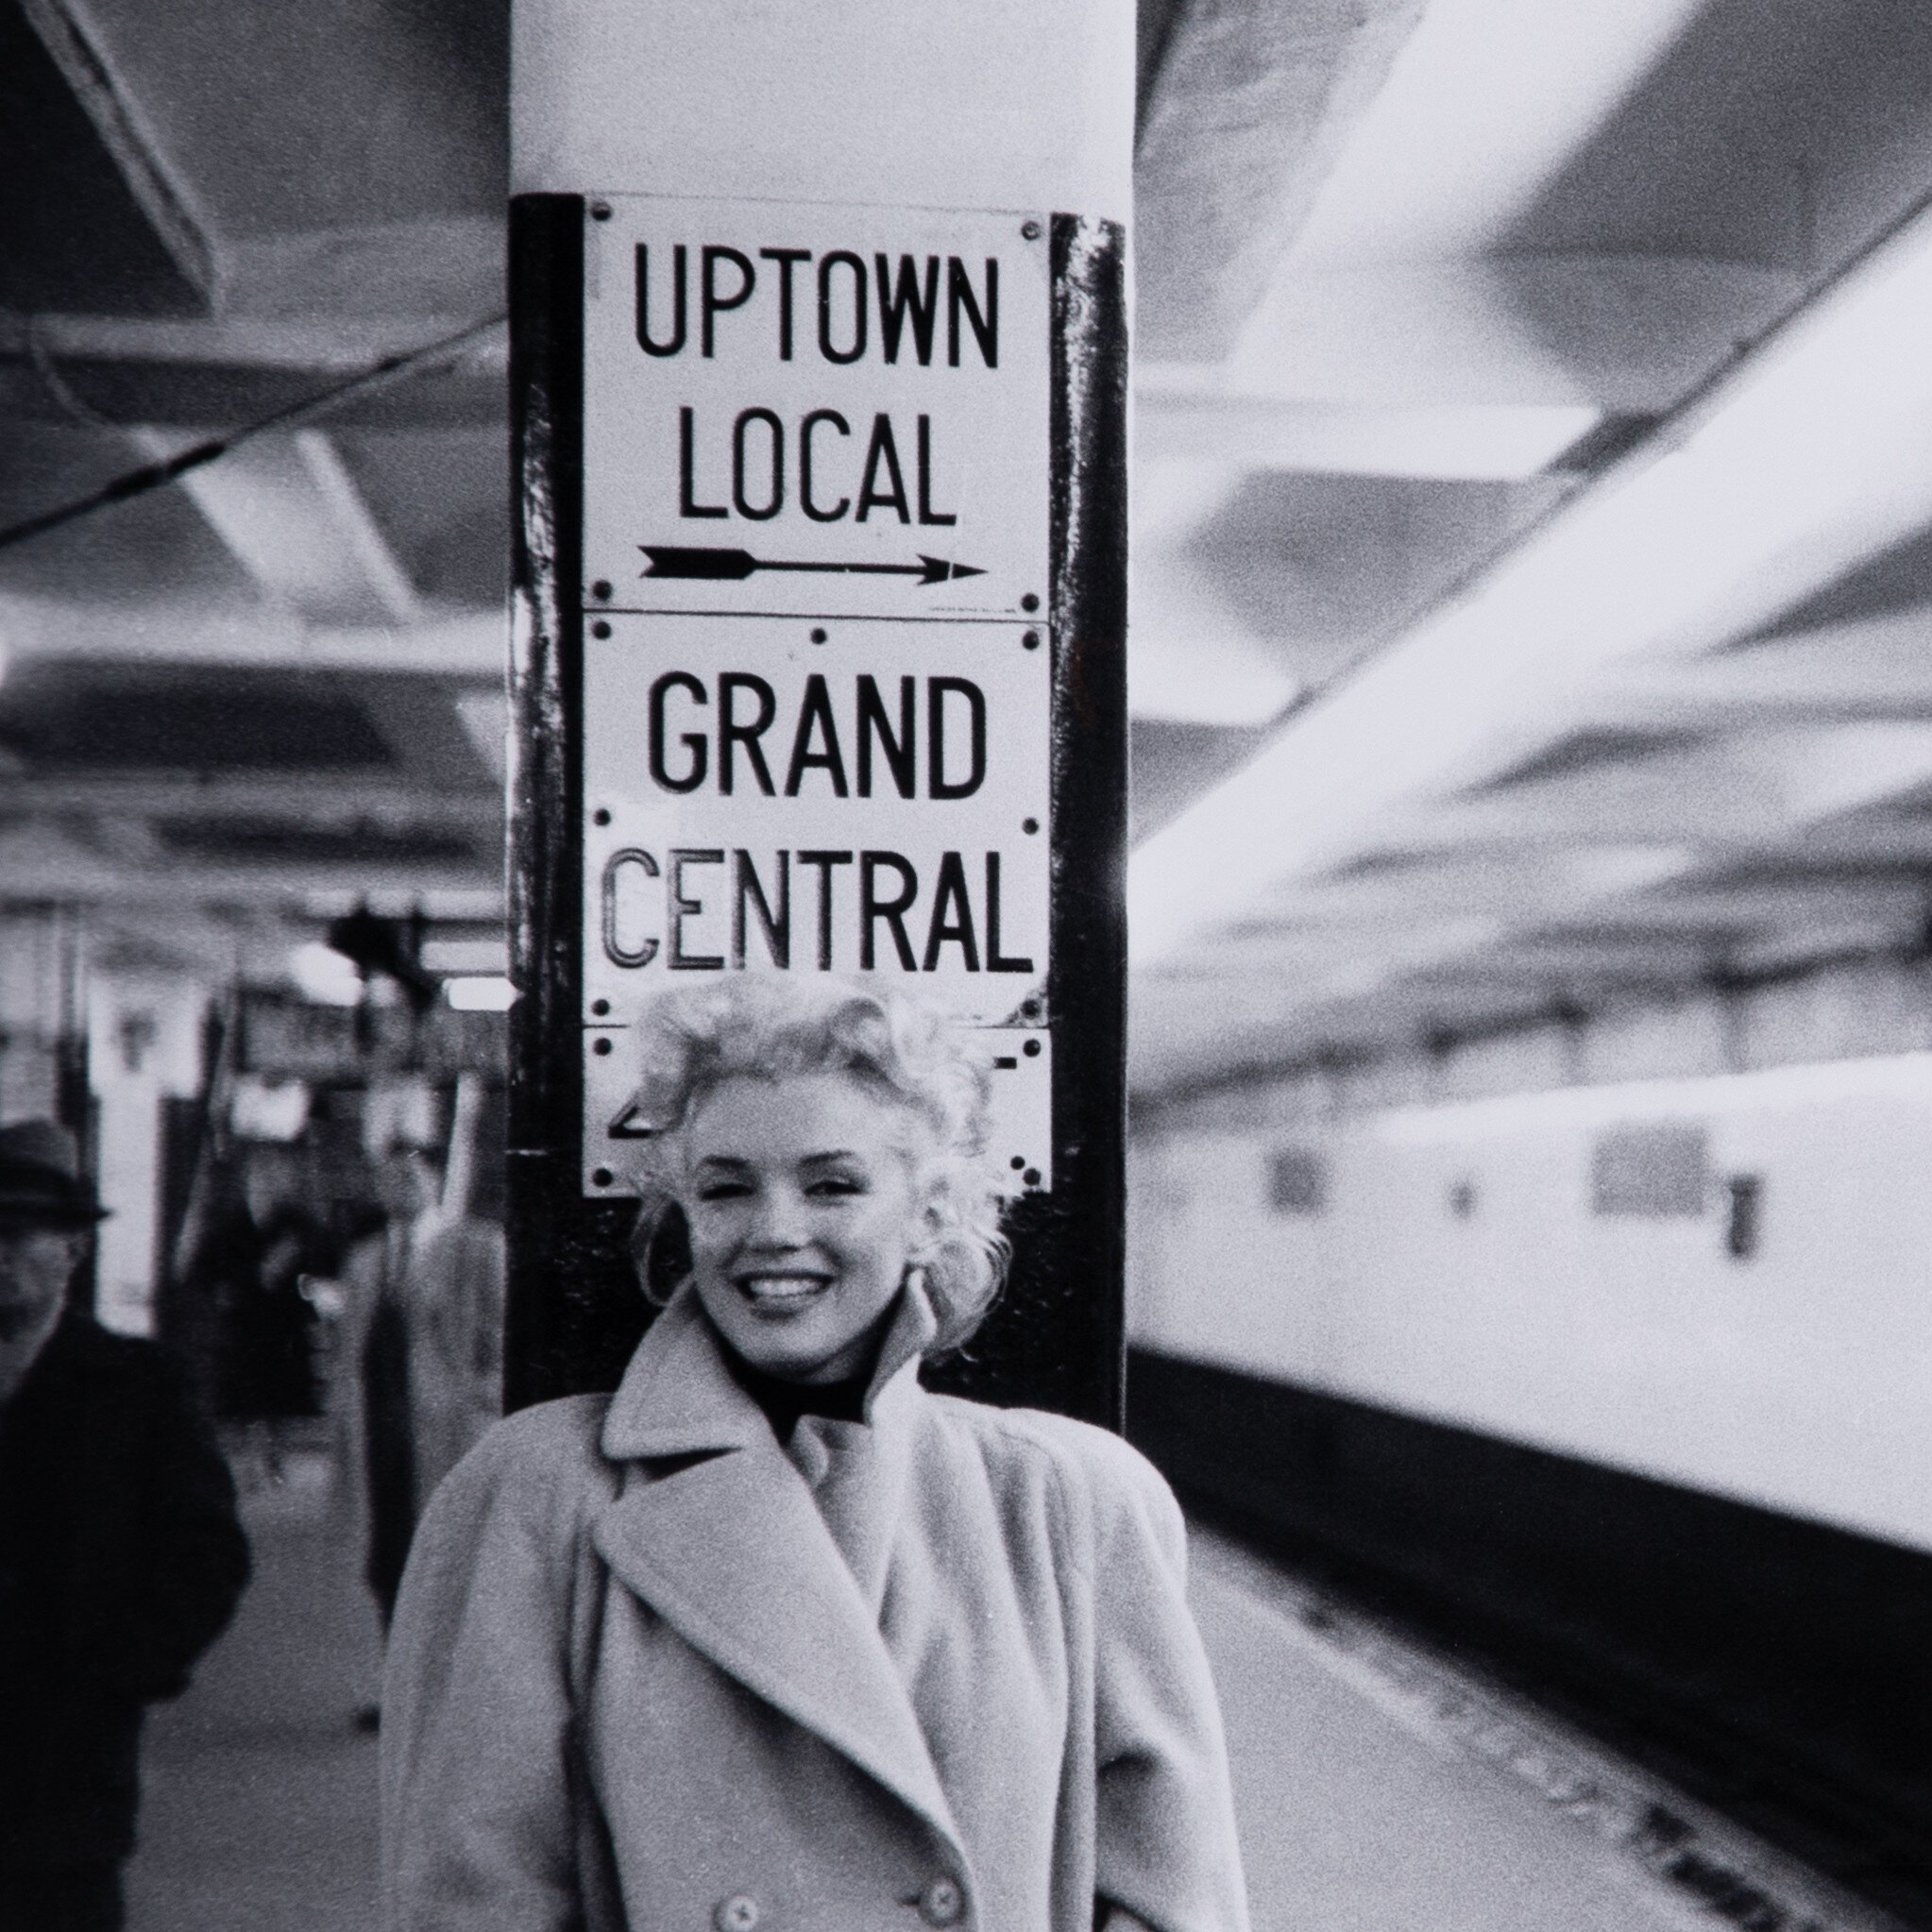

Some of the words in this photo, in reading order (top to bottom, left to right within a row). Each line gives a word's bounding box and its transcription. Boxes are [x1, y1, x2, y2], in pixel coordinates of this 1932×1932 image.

[635, 241, 999, 369] UPTOWN
[679, 406, 958, 527] LOCAL
[648, 669, 989, 802] GRAND
[602, 848, 1035, 974] CENTRAL
